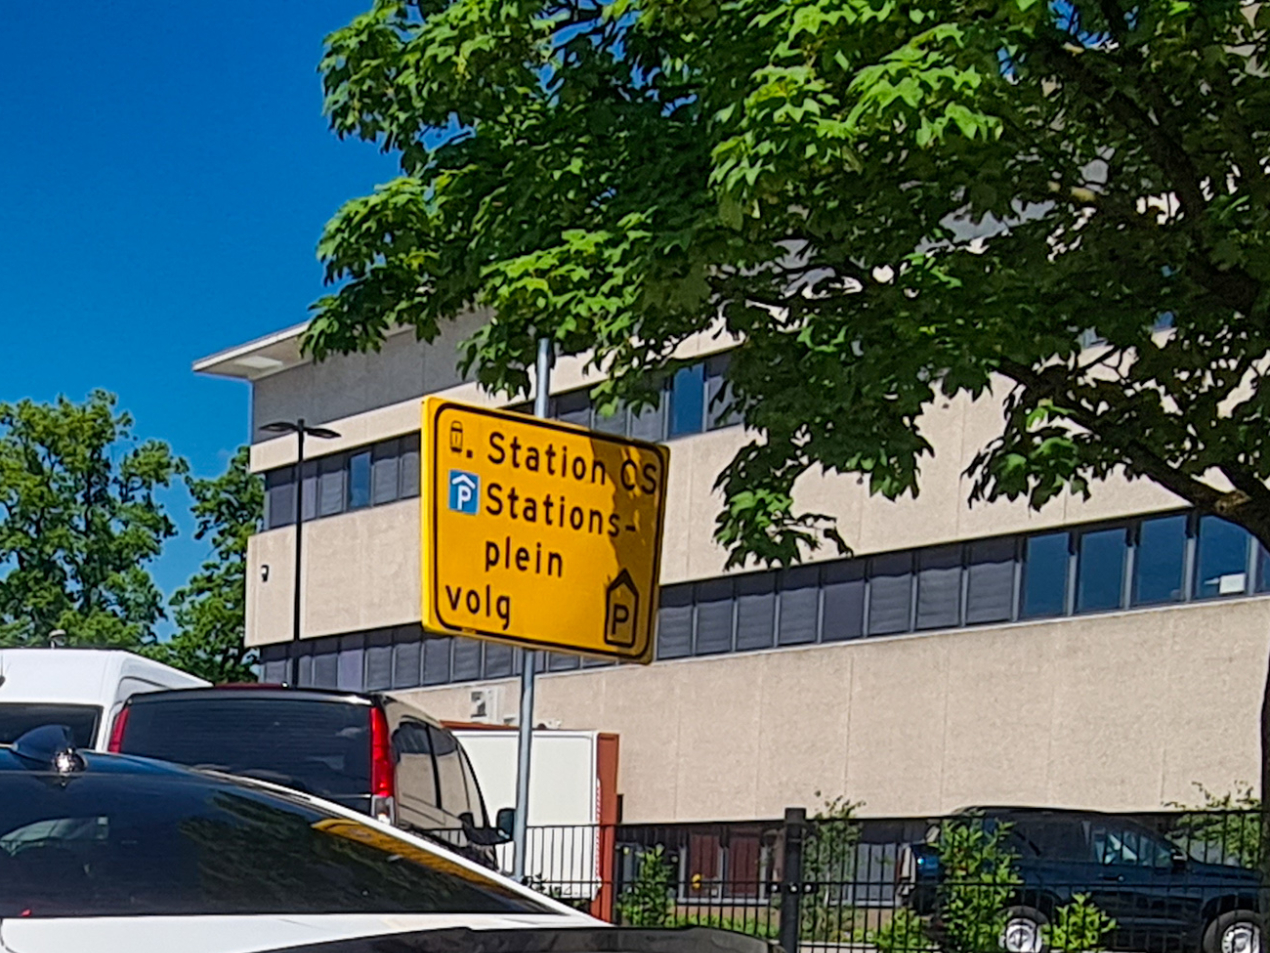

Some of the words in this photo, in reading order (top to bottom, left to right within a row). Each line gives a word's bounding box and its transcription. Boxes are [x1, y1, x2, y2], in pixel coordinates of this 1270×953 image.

[487, 431, 606, 485] Station
[620, 459, 657, 495] CS
[457, 485, 473, 511] P
[486, 482, 636, 538] Stations-
[485, 536, 563, 578] plein
[445, 585, 511, 631] volg
[612, 603, 629, 635] P
